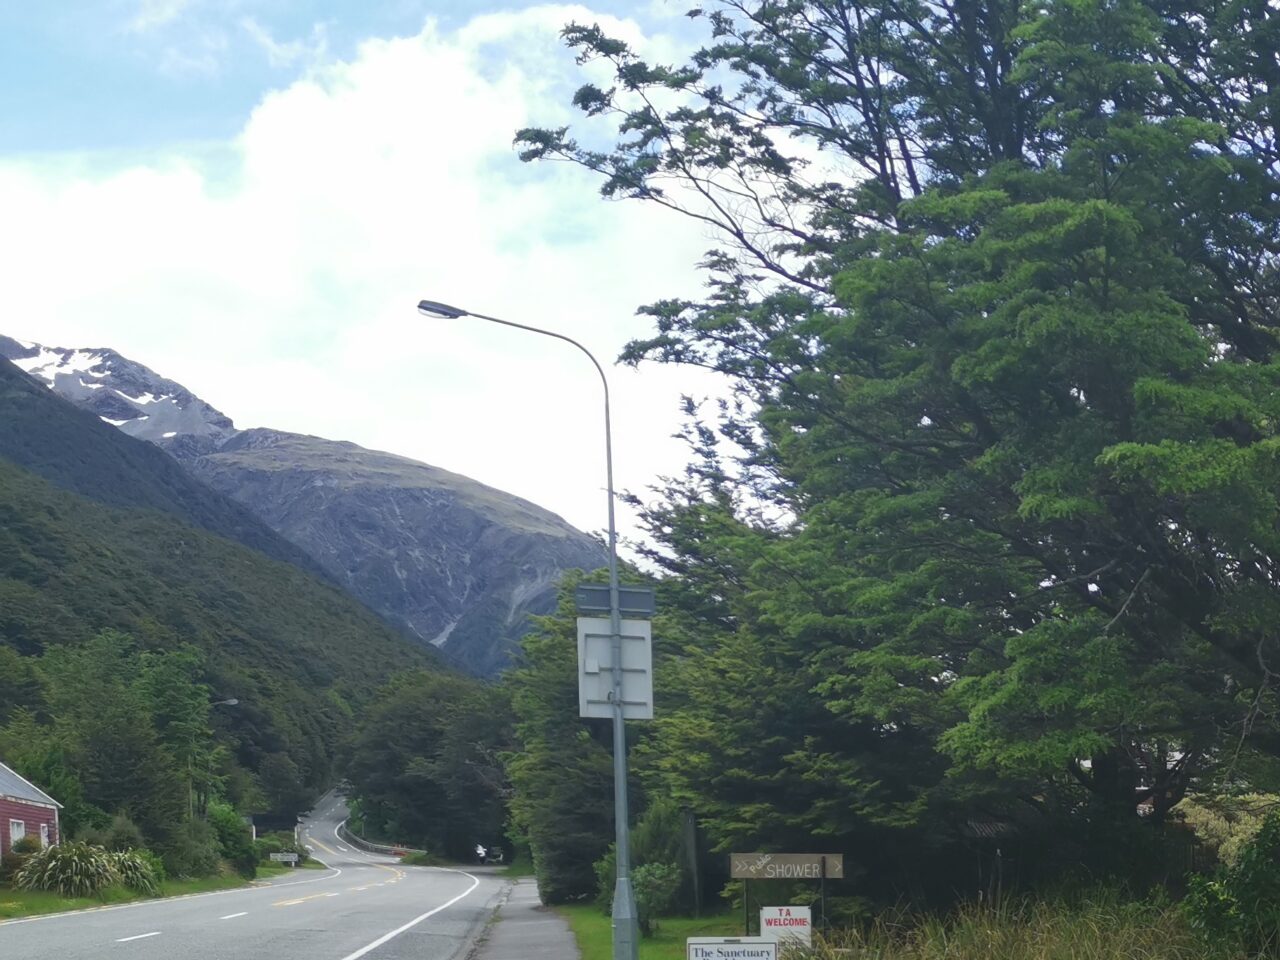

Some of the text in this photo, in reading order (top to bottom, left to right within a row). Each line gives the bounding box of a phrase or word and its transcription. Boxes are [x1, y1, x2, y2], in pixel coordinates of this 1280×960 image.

[764, 863, 820, 878] SHOWER
[765, 917, 808, 927] WELCOME
[692, 947, 772, 960] The Sanctuary
